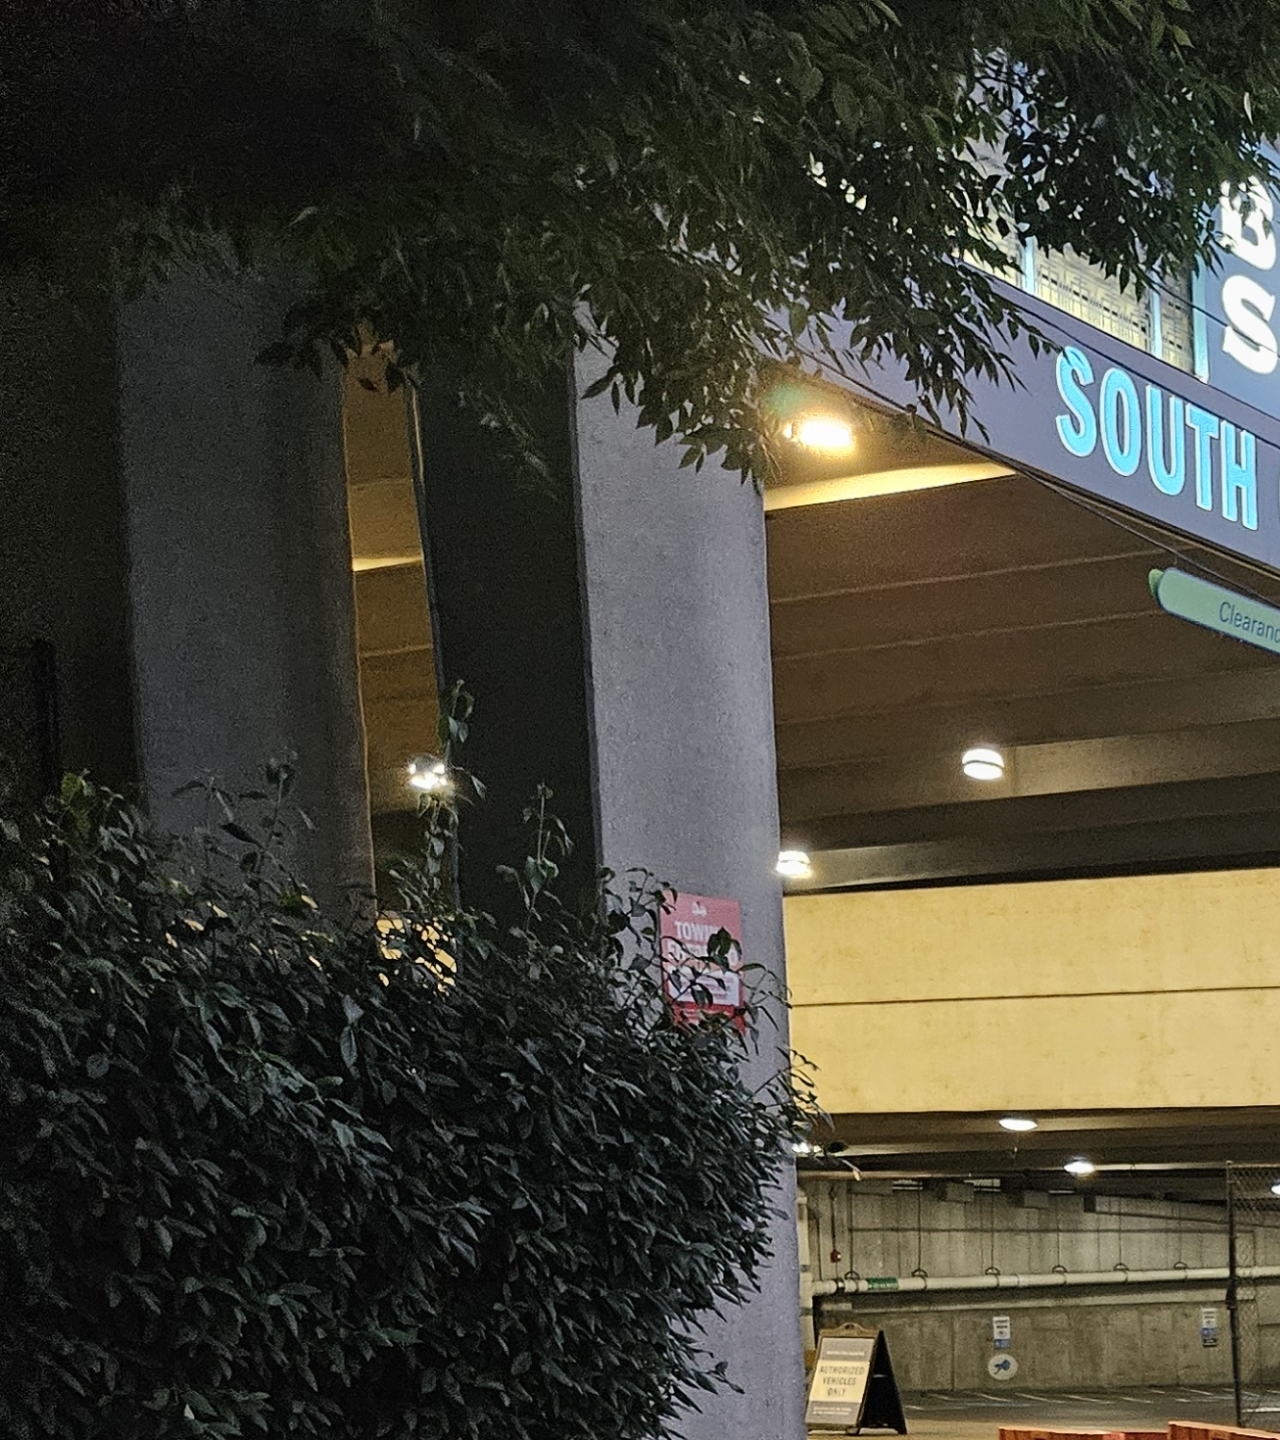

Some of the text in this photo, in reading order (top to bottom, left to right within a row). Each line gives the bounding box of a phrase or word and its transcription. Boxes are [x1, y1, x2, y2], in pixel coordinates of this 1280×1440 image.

[1055, 346, 1259, 531] SOUTH
[820, 1365, 865, 1375] AUTHORIZED
[822, 1376, 857, 1386] VEHICLES
[827, 1387, 847, 1397] ONLY
